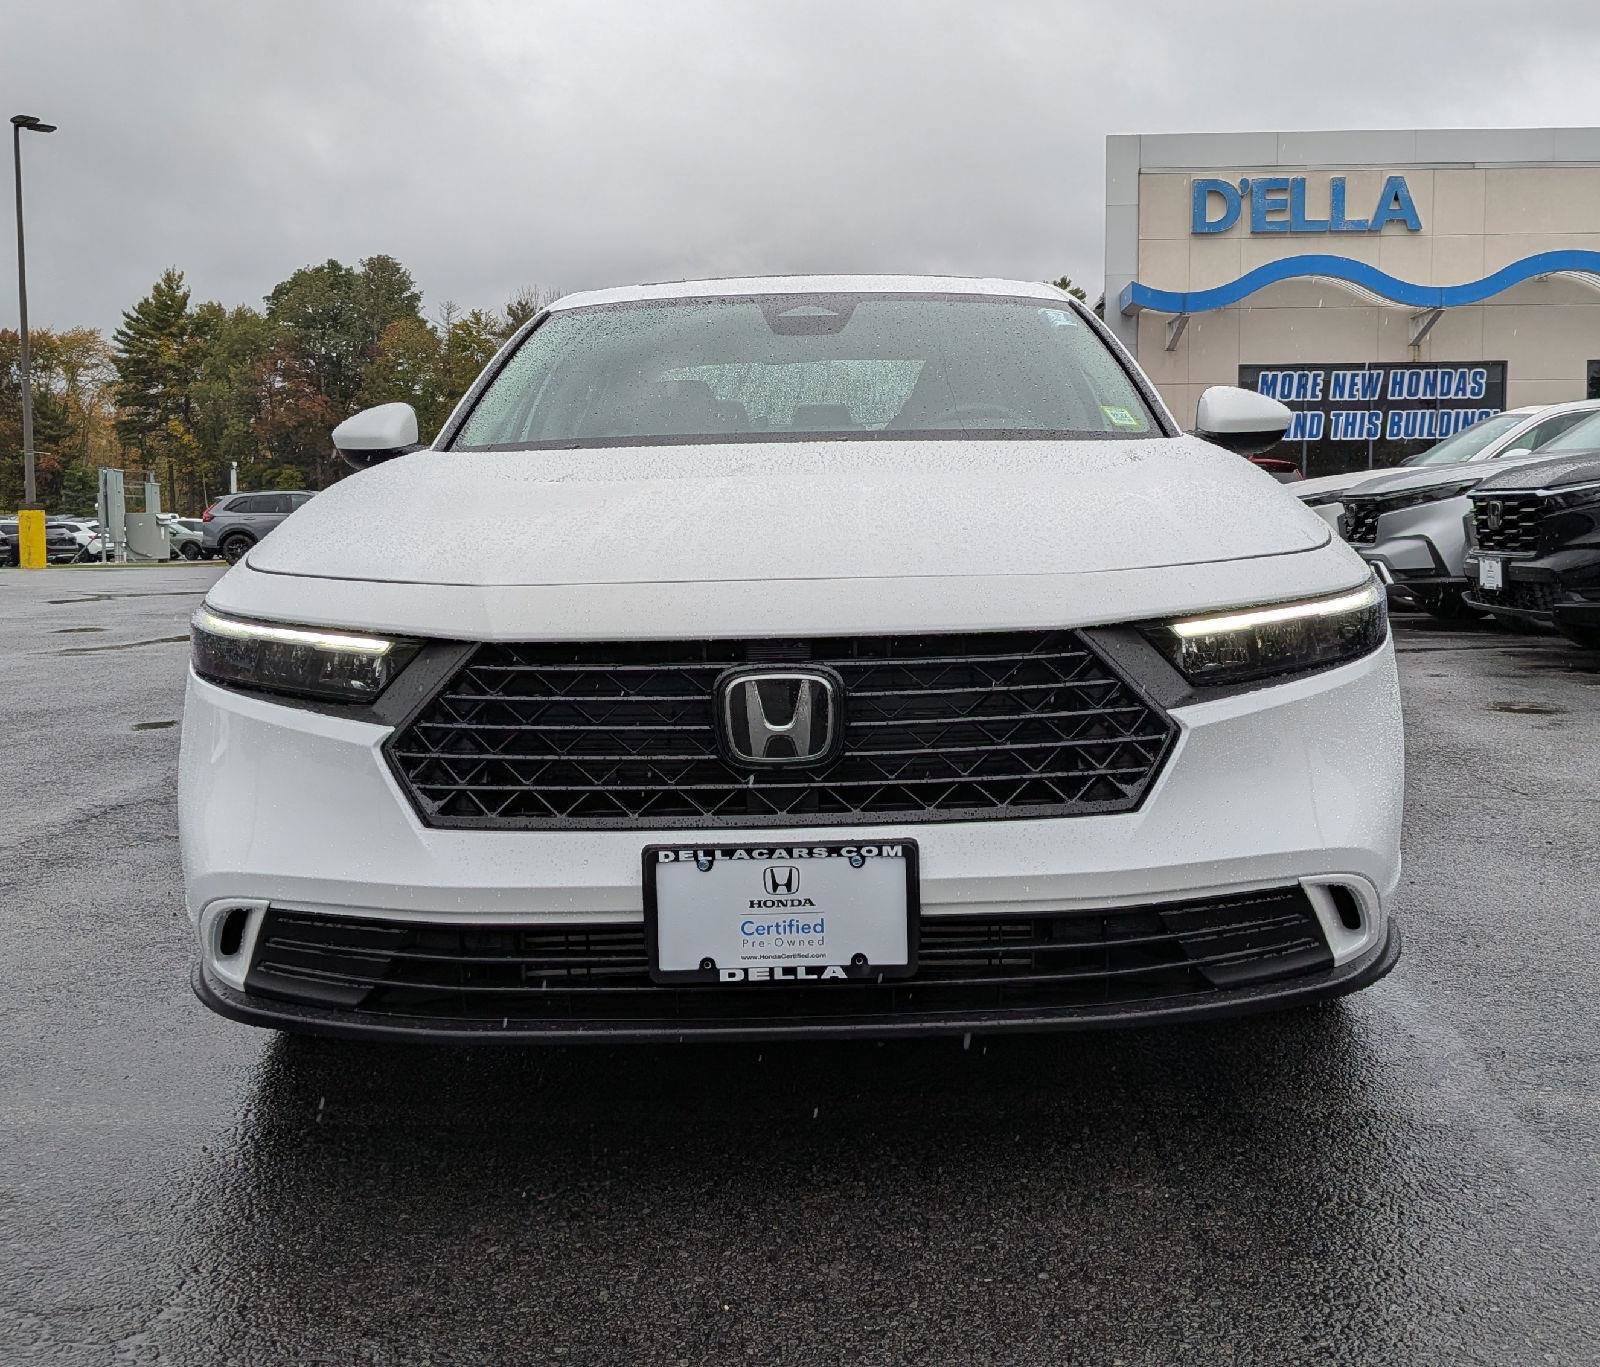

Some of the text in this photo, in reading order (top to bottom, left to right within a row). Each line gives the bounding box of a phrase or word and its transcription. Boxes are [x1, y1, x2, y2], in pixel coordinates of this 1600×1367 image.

[1191, 175, 1422, 235] D'ELLA
[1258, 368, 1487, 401] MORE NEW HONDAS
[1330, 410, 1383, 440] THIS
[1386, 409, 1500, 440] BUILDIN
[658, 845, 904, 863] DELLACARS.COM
[749, 898, 816, 908] HONDA
[741, 918, 825, 936] Certified
[742, 936, 825, 948] Pre-Owned
[719, 965, 848, 982] DELLA
